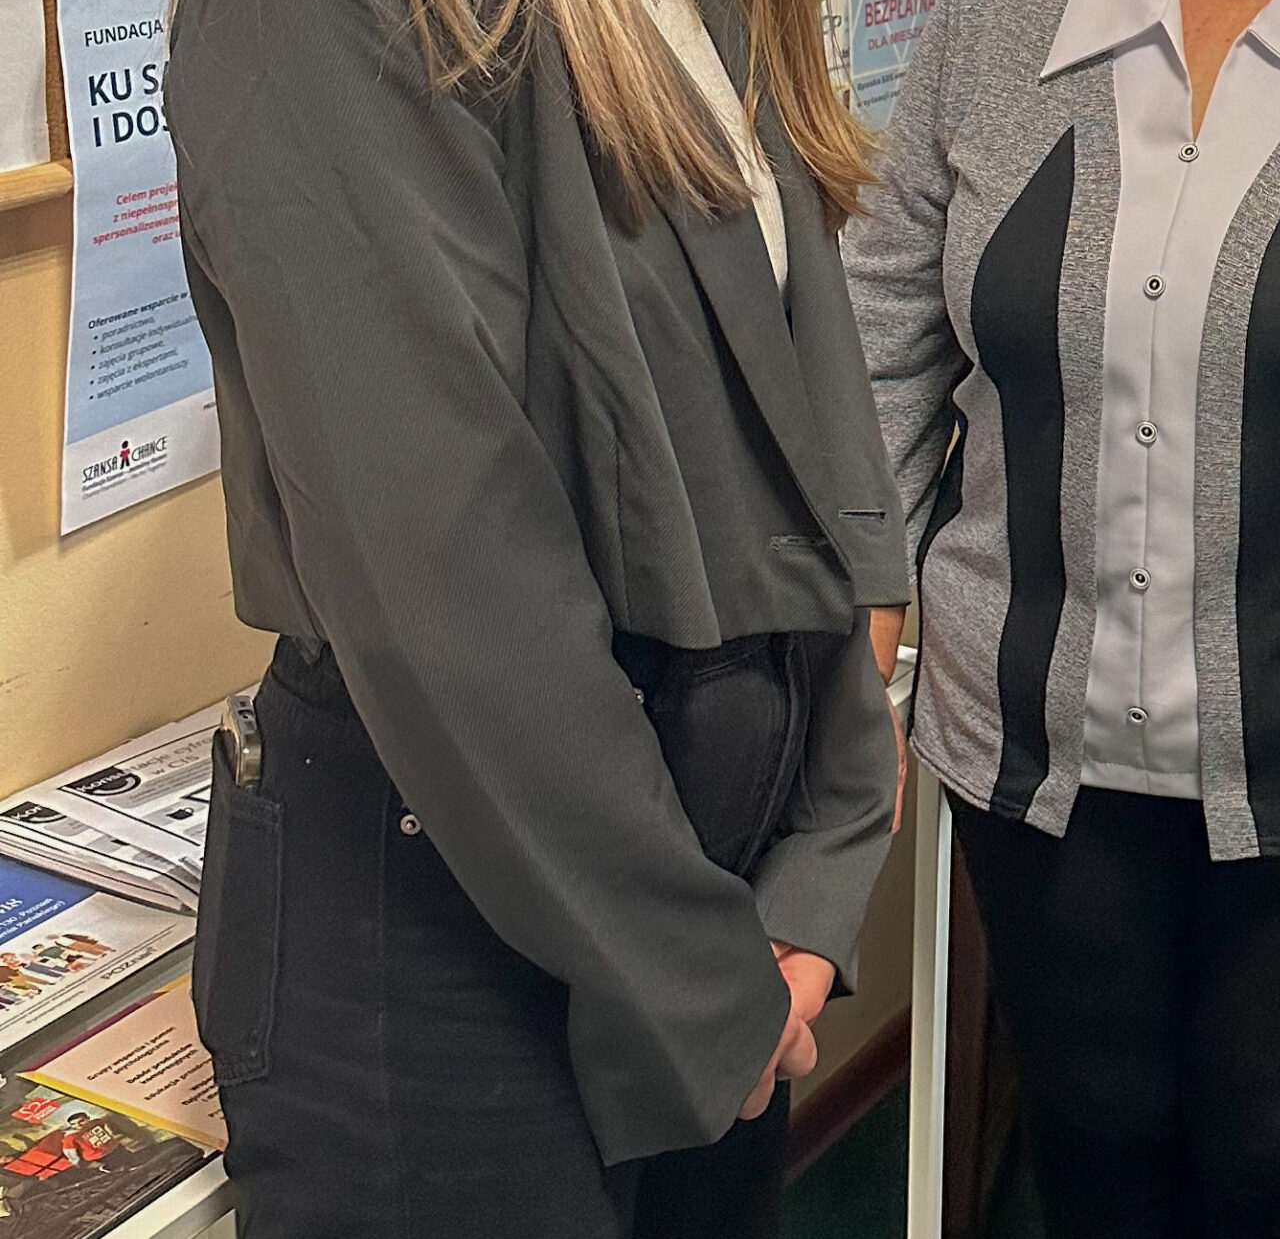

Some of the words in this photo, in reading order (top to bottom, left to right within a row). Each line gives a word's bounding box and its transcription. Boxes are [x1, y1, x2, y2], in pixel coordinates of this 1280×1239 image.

[84, 19, 164, 47] FUNDACJA
[89, 69, 132, 106] KU
[93, 117, 102, 147] I
[112, 106, 169, 143] DO
[116, 191, 147, 206] Celem
[88, 308, 139, 329] Oferowane
[82, 456, 118, 483] SZANSA
[131, 435, 168, 462] CHANCE
